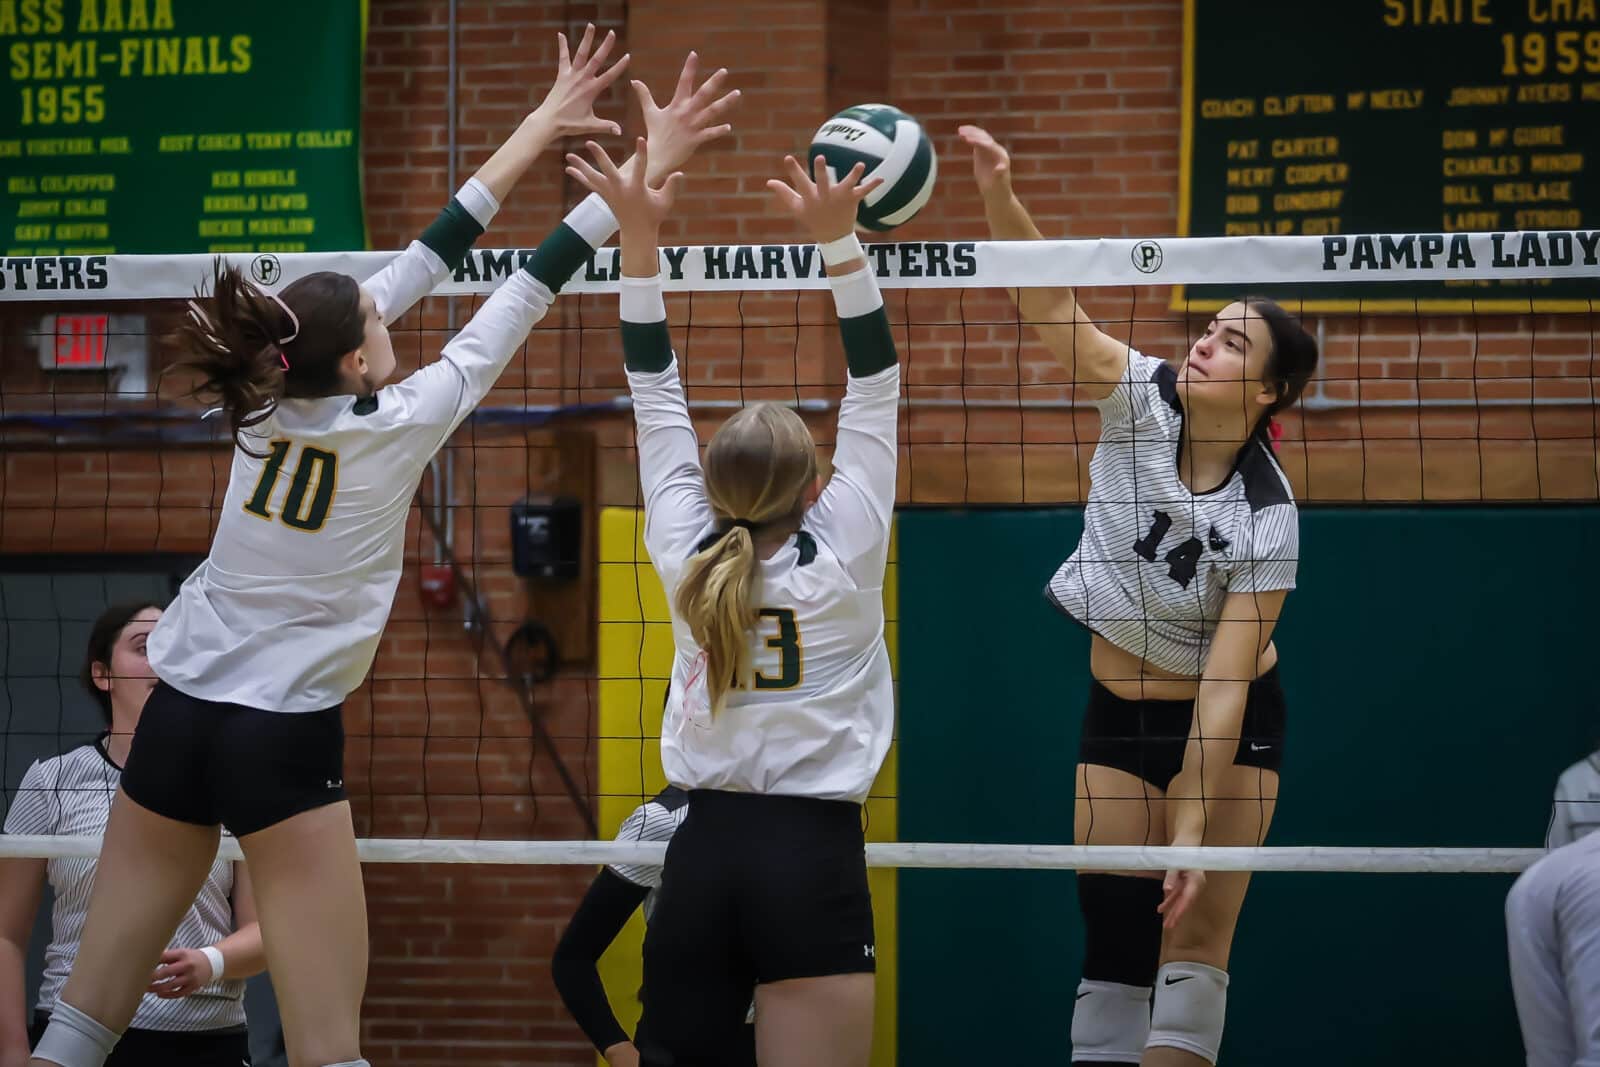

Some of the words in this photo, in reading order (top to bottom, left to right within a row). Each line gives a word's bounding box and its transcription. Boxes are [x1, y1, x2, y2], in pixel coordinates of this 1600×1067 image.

[78, 0, 174, 32] AAAA
[1384, 0, 1493, 26] STATE
[10, 35, 252, 80] SEMI-FINALS
[1502, 31, 1600, 75] 1959
[21, 85, 105, 125] 1955
[1201, 98, 1254, 118] COACH
[1227, 140, 1258, 160] PAT
[1272, 136, 1339, 158] CARTER
[1286, 163, 1348, 185] COOPER
[1443, 157, 1520, 177] CHARLES
[1443, 186, 1481, 205] BILL
[1443, 213, 1498, 231] LARRY
[704, 243, 977, 280] HARVTERS
[1322, 234, 1476, 270] PAMPA
[1491, 231, 1600, 268] LADY
[0, 256, 107, 290] TERS
[55, 316, 107, 363] EXIT
[242, 438, 340, 534] 10
[1132, 508, 1204, 591] 14
